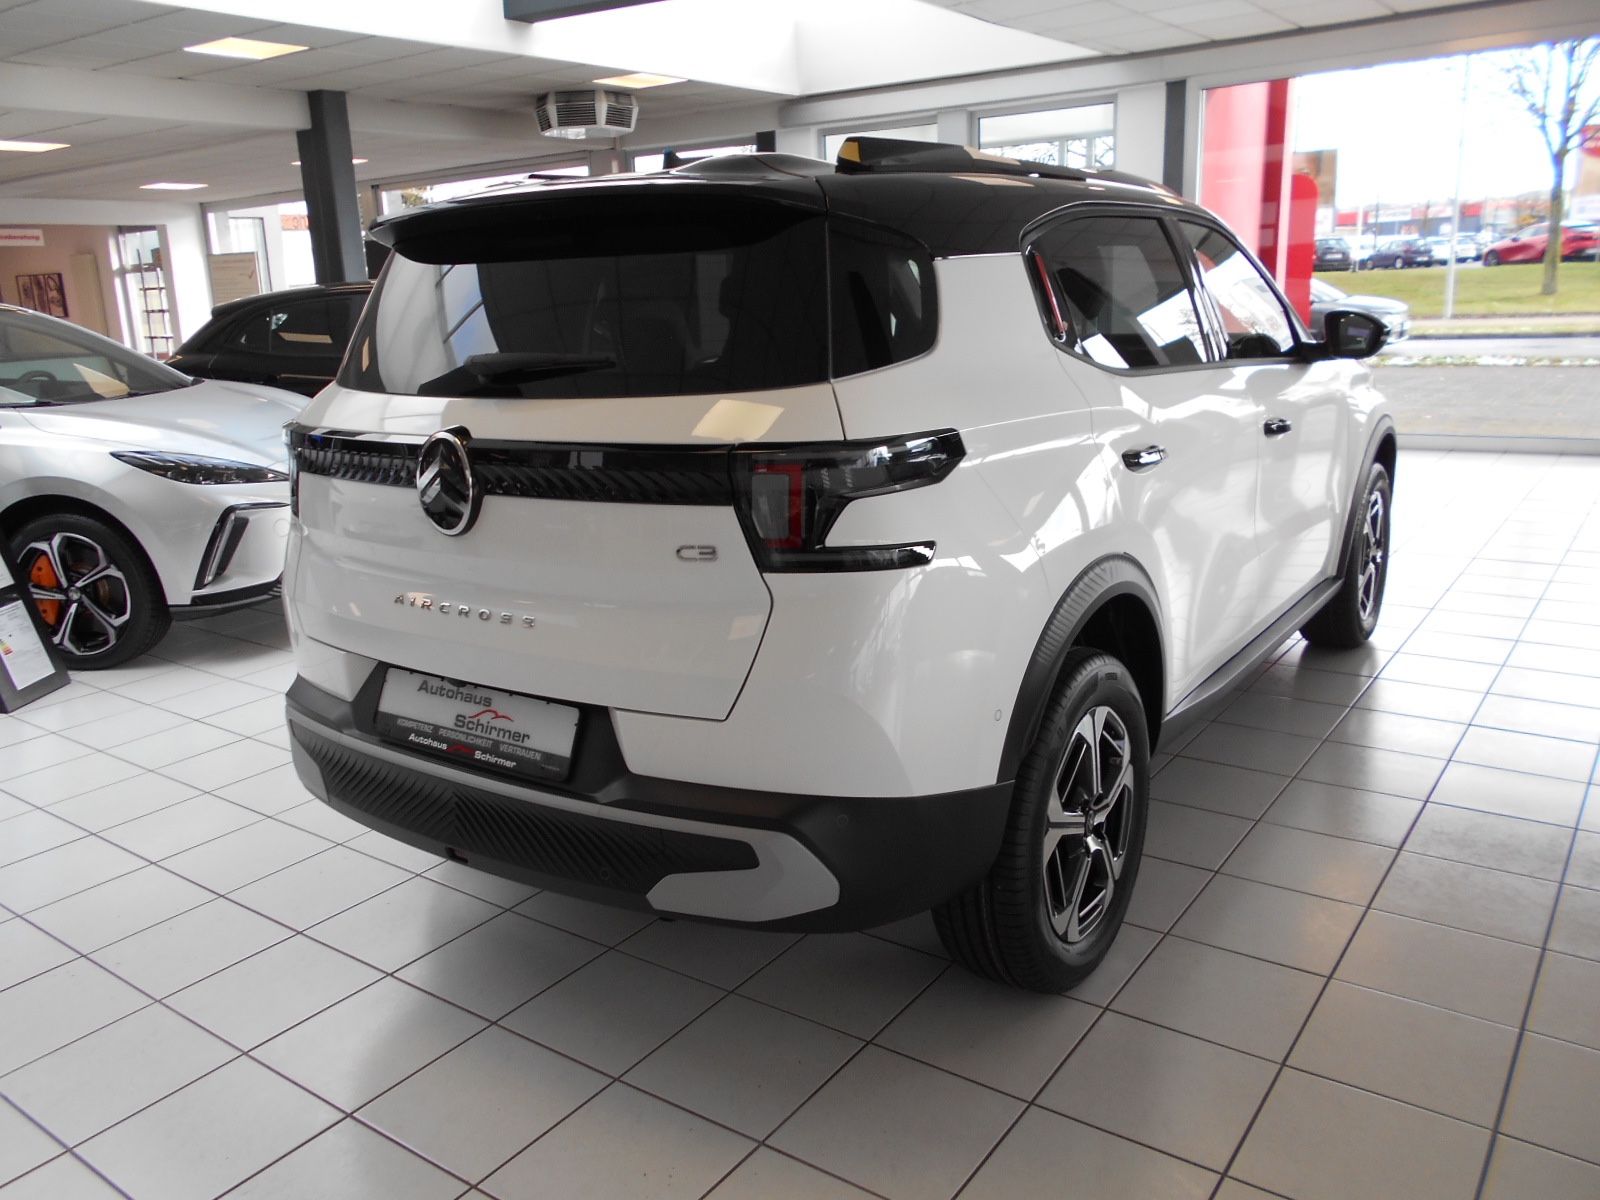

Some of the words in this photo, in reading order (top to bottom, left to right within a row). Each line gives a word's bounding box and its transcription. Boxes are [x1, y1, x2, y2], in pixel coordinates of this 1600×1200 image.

[676, 545, 717, 562] C3
[394, 594, 535, 628] AIRCROSS
[417, 679, 493, 707] Autohaus
[454, 714, 530, 744] Schirmer
[408, 733, 448, 750] Autohaus
[474, 750, 517, 768] Schirmer
[500, 743, 542, 761] VERTRAUEN
